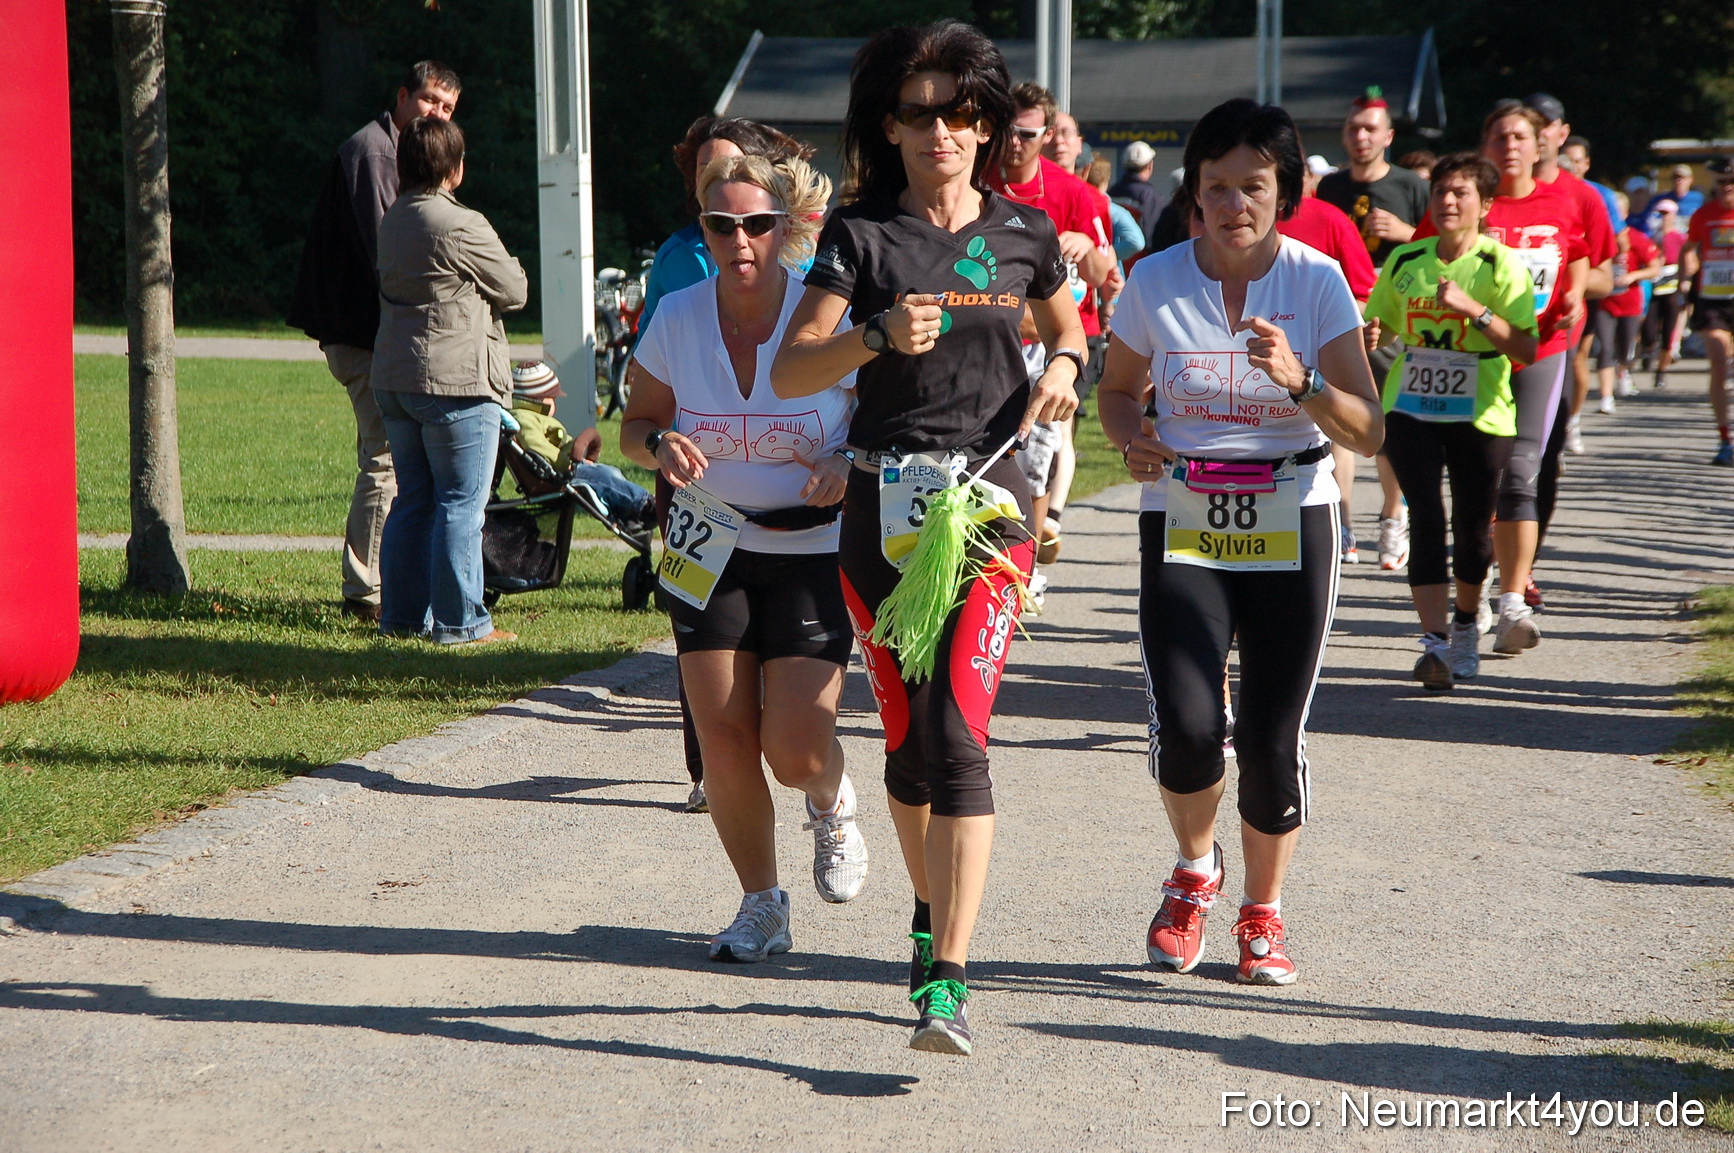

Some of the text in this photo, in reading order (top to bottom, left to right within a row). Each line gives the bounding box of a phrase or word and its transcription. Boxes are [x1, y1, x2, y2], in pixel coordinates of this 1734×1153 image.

[1408, 366, 1468, 395] 2932
[1184, 405, 1210, 415] RUN
[1237, 404, 1296, 416] NOT RUN
[1421, 396, 1447, 411] Rita
[1207, 492, 1258, 530] 88
[1199, 531, 1266, 559] Sylvia
